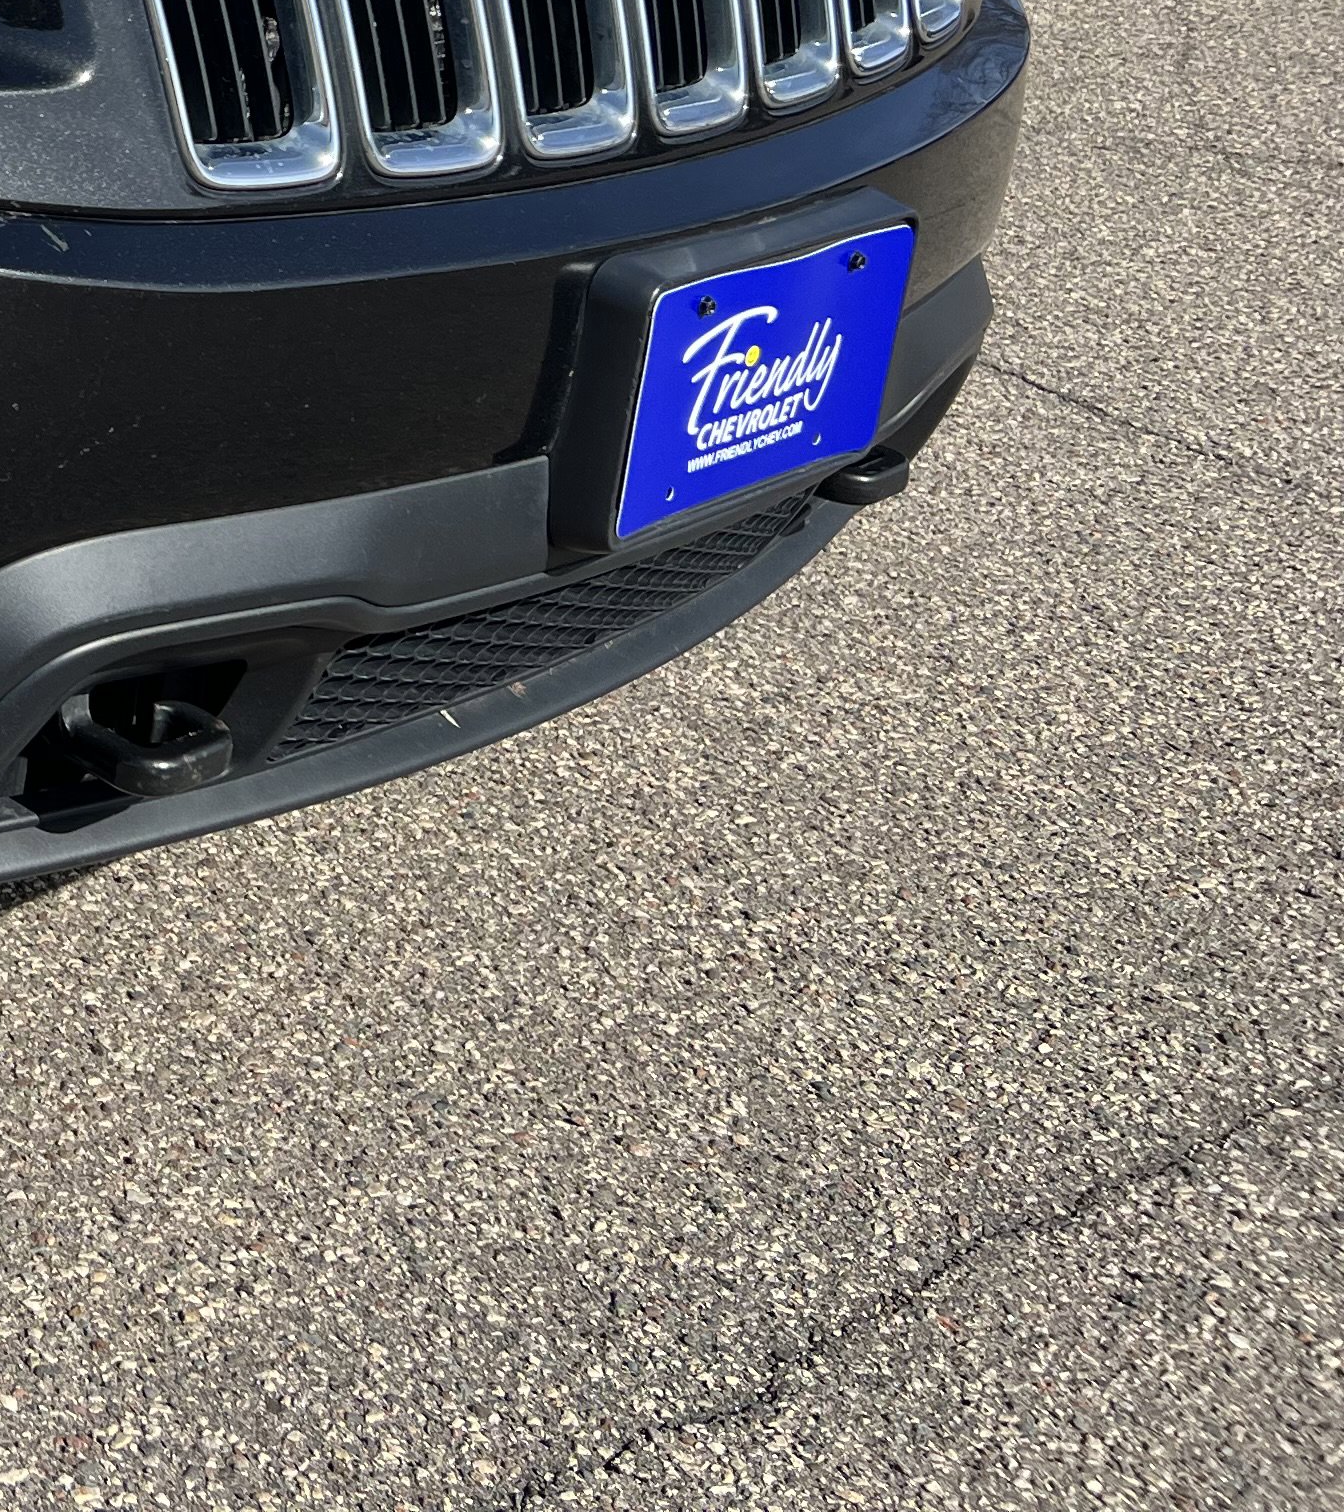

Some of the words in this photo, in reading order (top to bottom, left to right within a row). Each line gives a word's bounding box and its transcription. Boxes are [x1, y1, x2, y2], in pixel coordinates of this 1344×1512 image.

[682, 305, 842, 436] Friendly
[687, 420, 804, 473] WWW.FRIENDLYCHEV.COM
[696, 392, 805, 451] CHEVROLET
